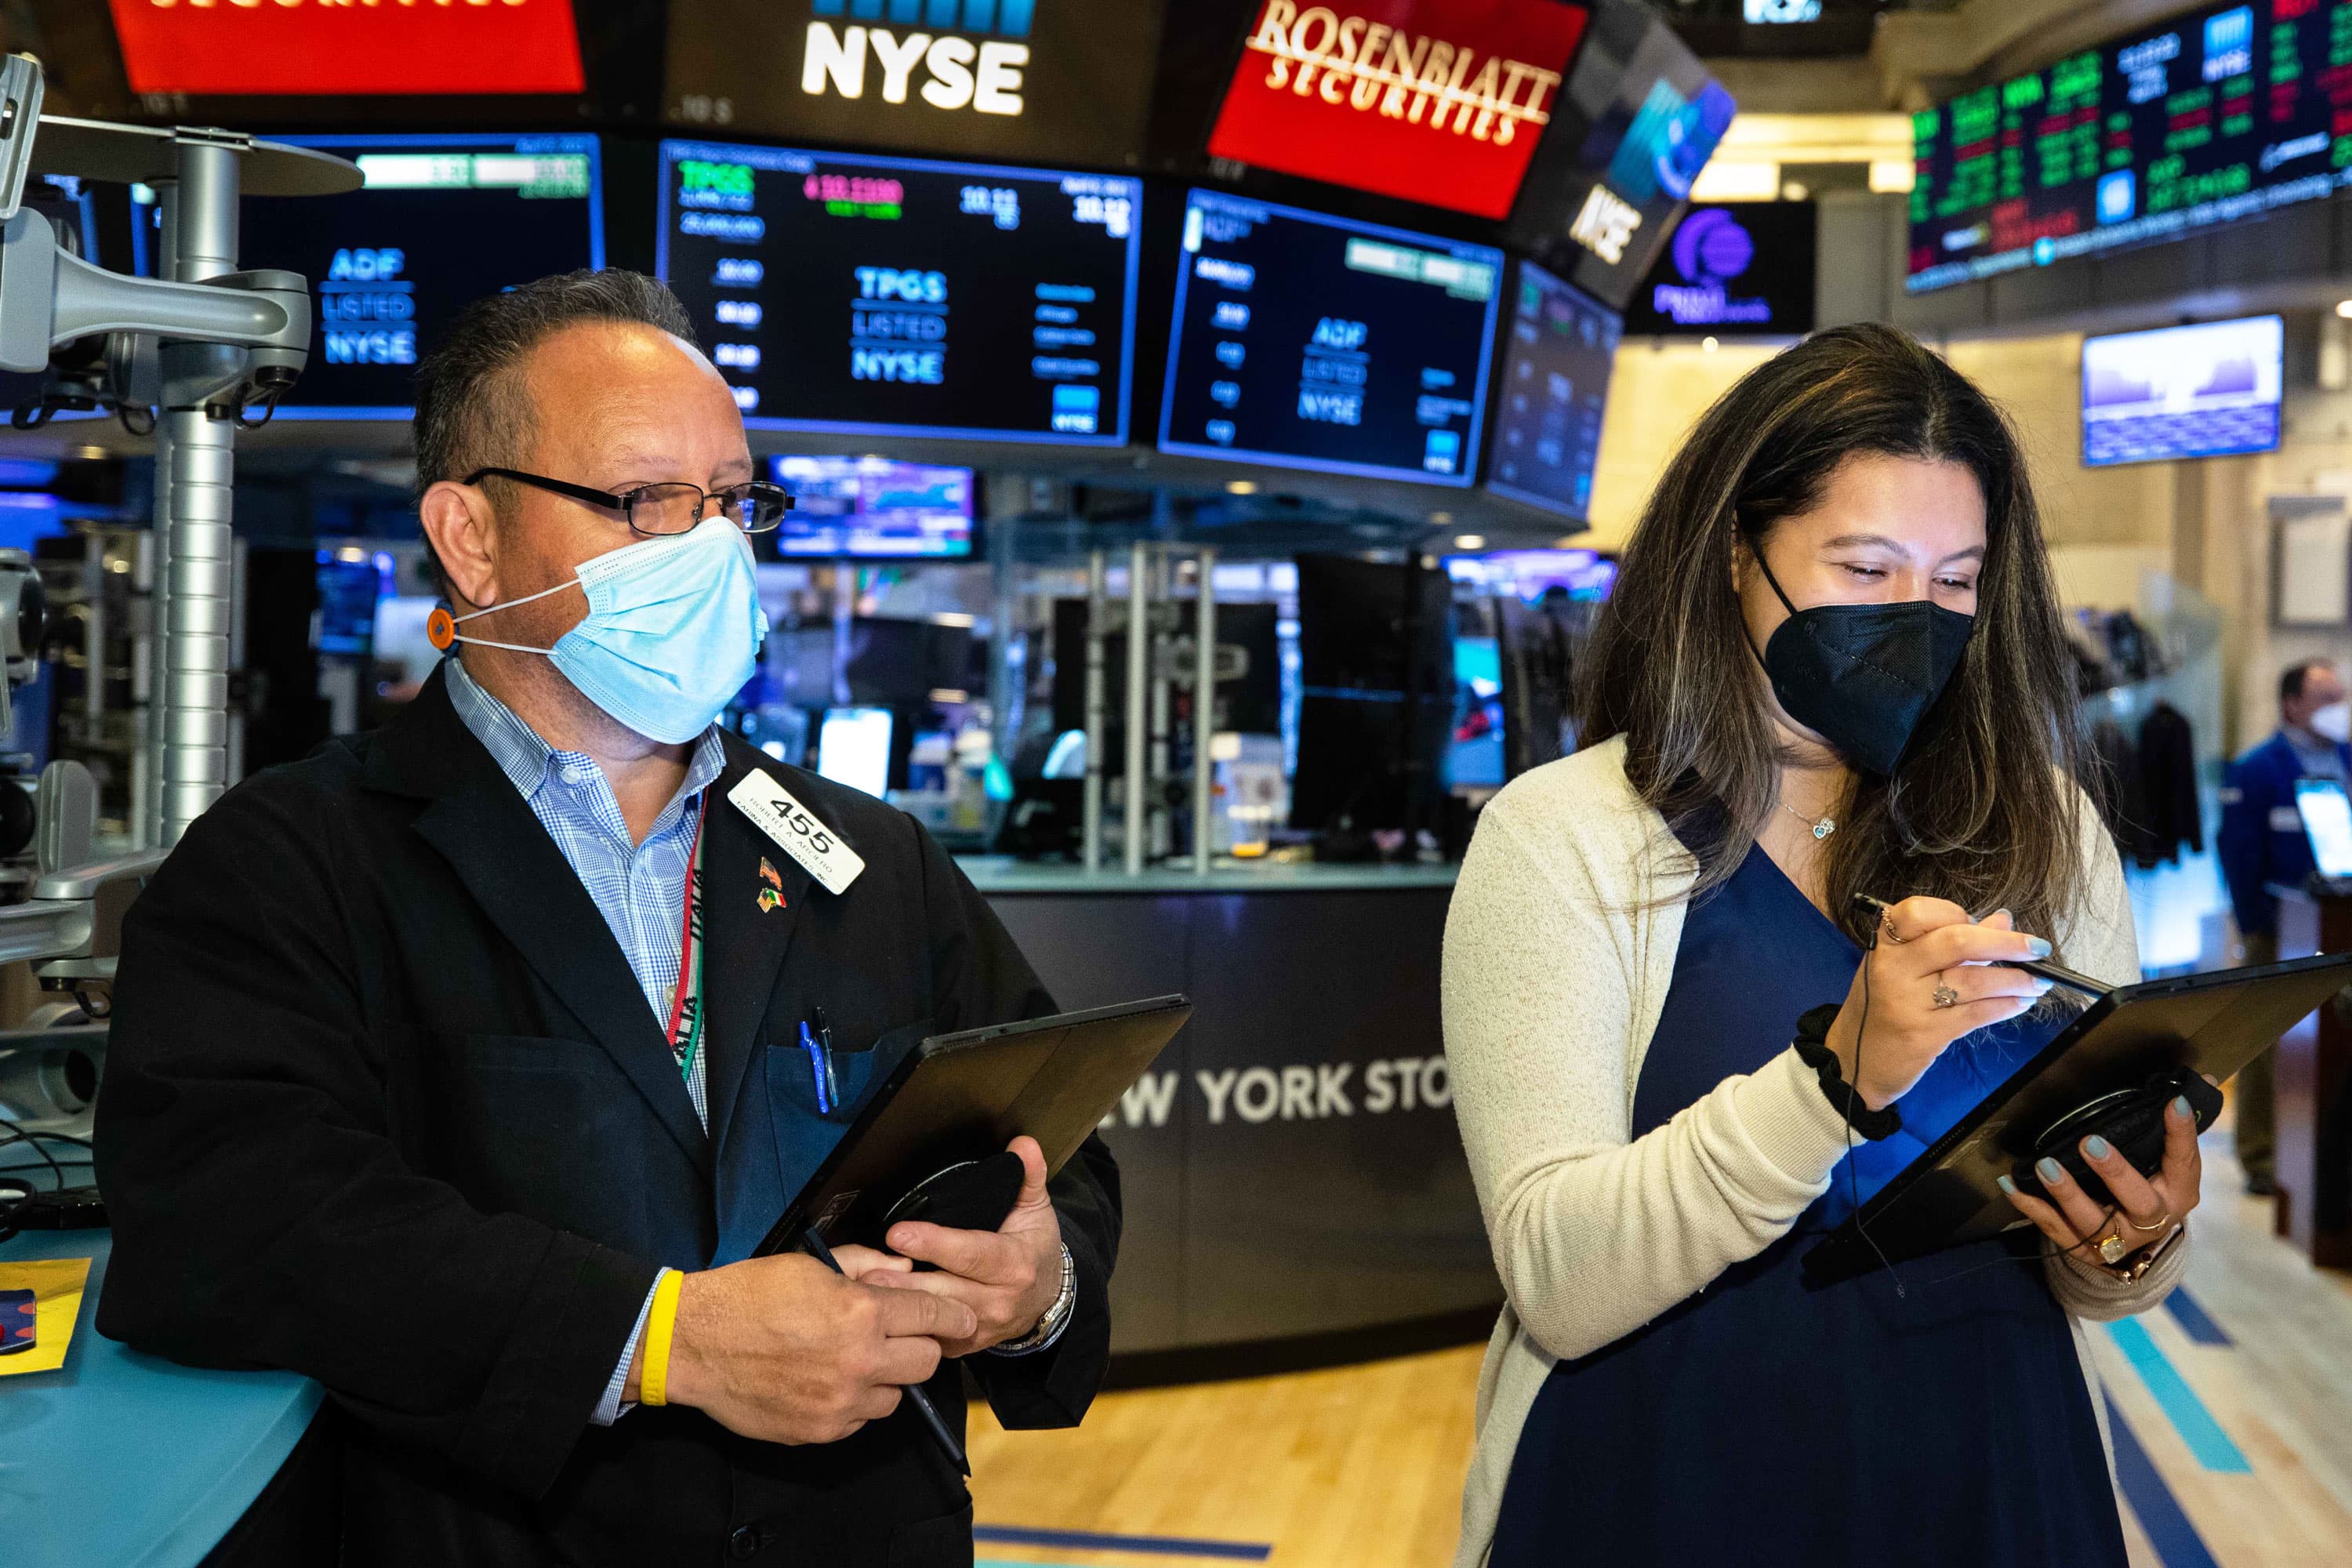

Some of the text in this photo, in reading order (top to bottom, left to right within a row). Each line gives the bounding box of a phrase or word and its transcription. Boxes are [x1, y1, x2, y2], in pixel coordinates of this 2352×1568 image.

[801, 21, 1030, 116] NYSE
[1254, 0, 1562, 118] ROSENBLATT
[1265, 55, 1519, 147] SECURITIES
[855, 266, 947, 303] TPGS
[325, 330, 416, 364] NYSE
[851, 347, 945, 384] NYSE
[770, 800, 834, 854] 455
[690, 869, 703, 942] ITALIA
[1193, 1062, 1355, 1124] YORK
